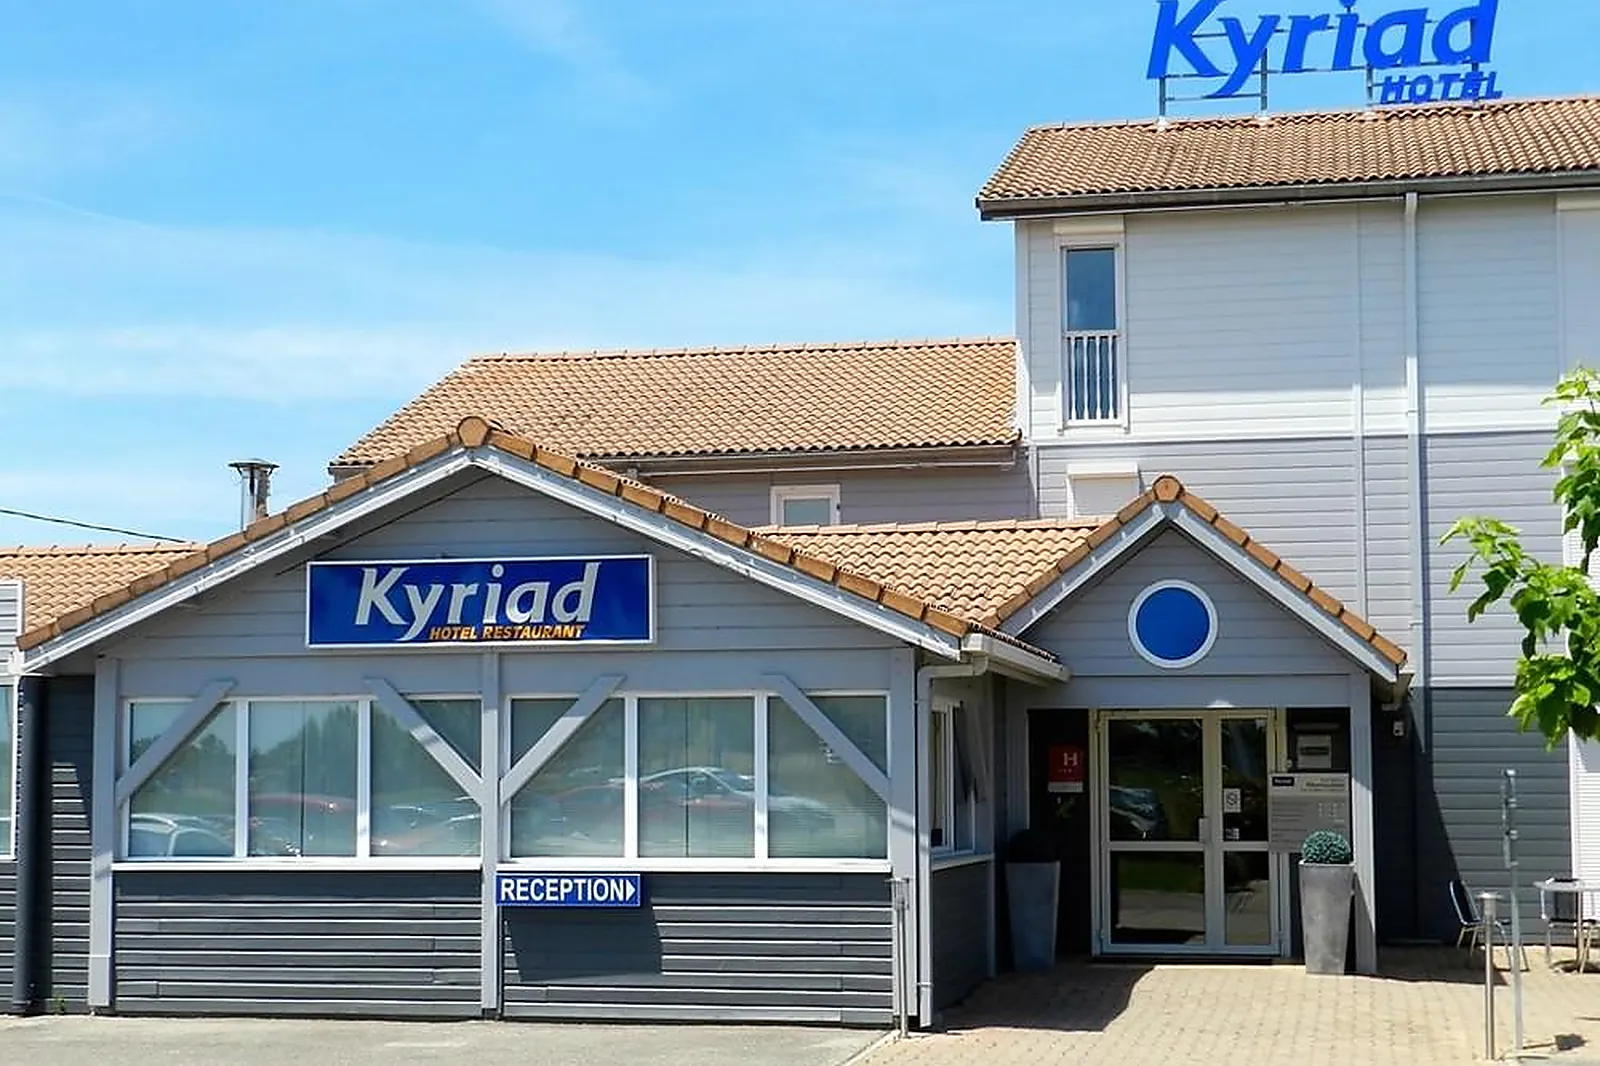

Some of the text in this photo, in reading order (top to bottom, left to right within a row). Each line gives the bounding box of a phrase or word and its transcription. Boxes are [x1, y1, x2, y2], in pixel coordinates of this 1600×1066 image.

[1146, 0, 1499, 98] Kyriad
[1380, 71, 1502, 104] HOTEL
[355, 562, 601, 641] Kyriad
[429, 625, 585, 640] HOTEL RESTAURANT
[1063, 752, 1078, 766] H
[501, 878, 624, 901] RECEPTION
